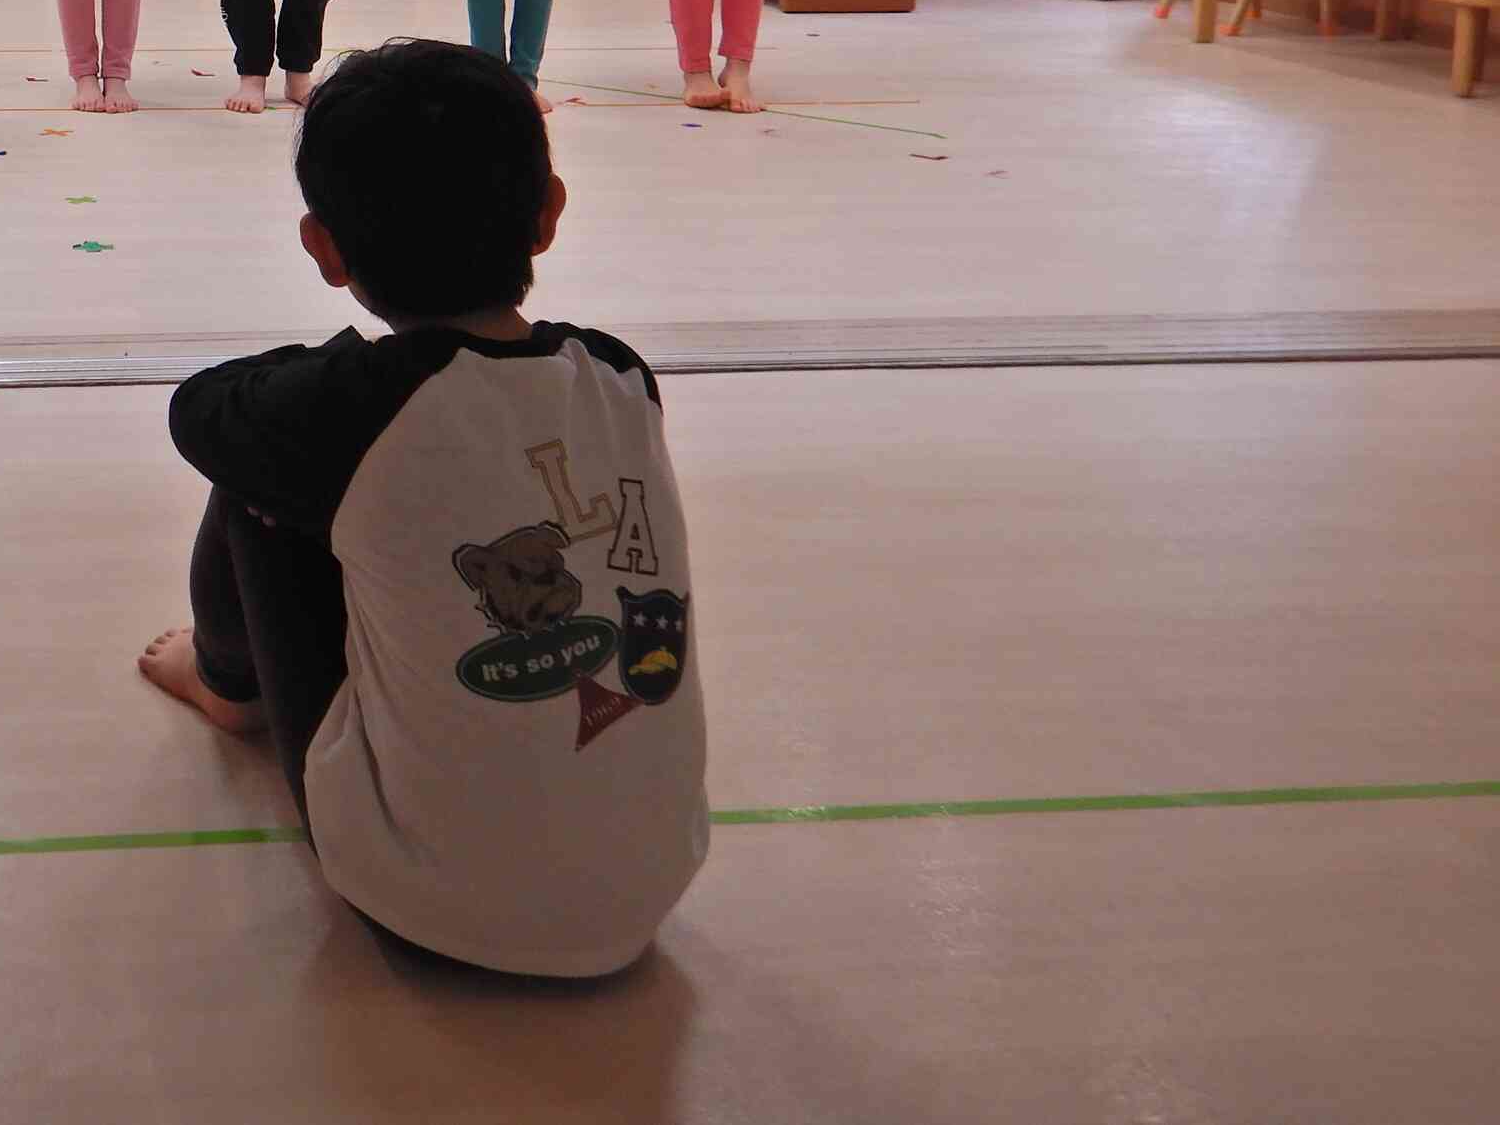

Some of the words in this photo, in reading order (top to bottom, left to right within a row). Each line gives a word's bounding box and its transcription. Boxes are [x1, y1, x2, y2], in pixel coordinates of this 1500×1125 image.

[481, 662, 518, 682] It's
[526, 654, 554, 674] so
[560, 634, 600, 666] you
